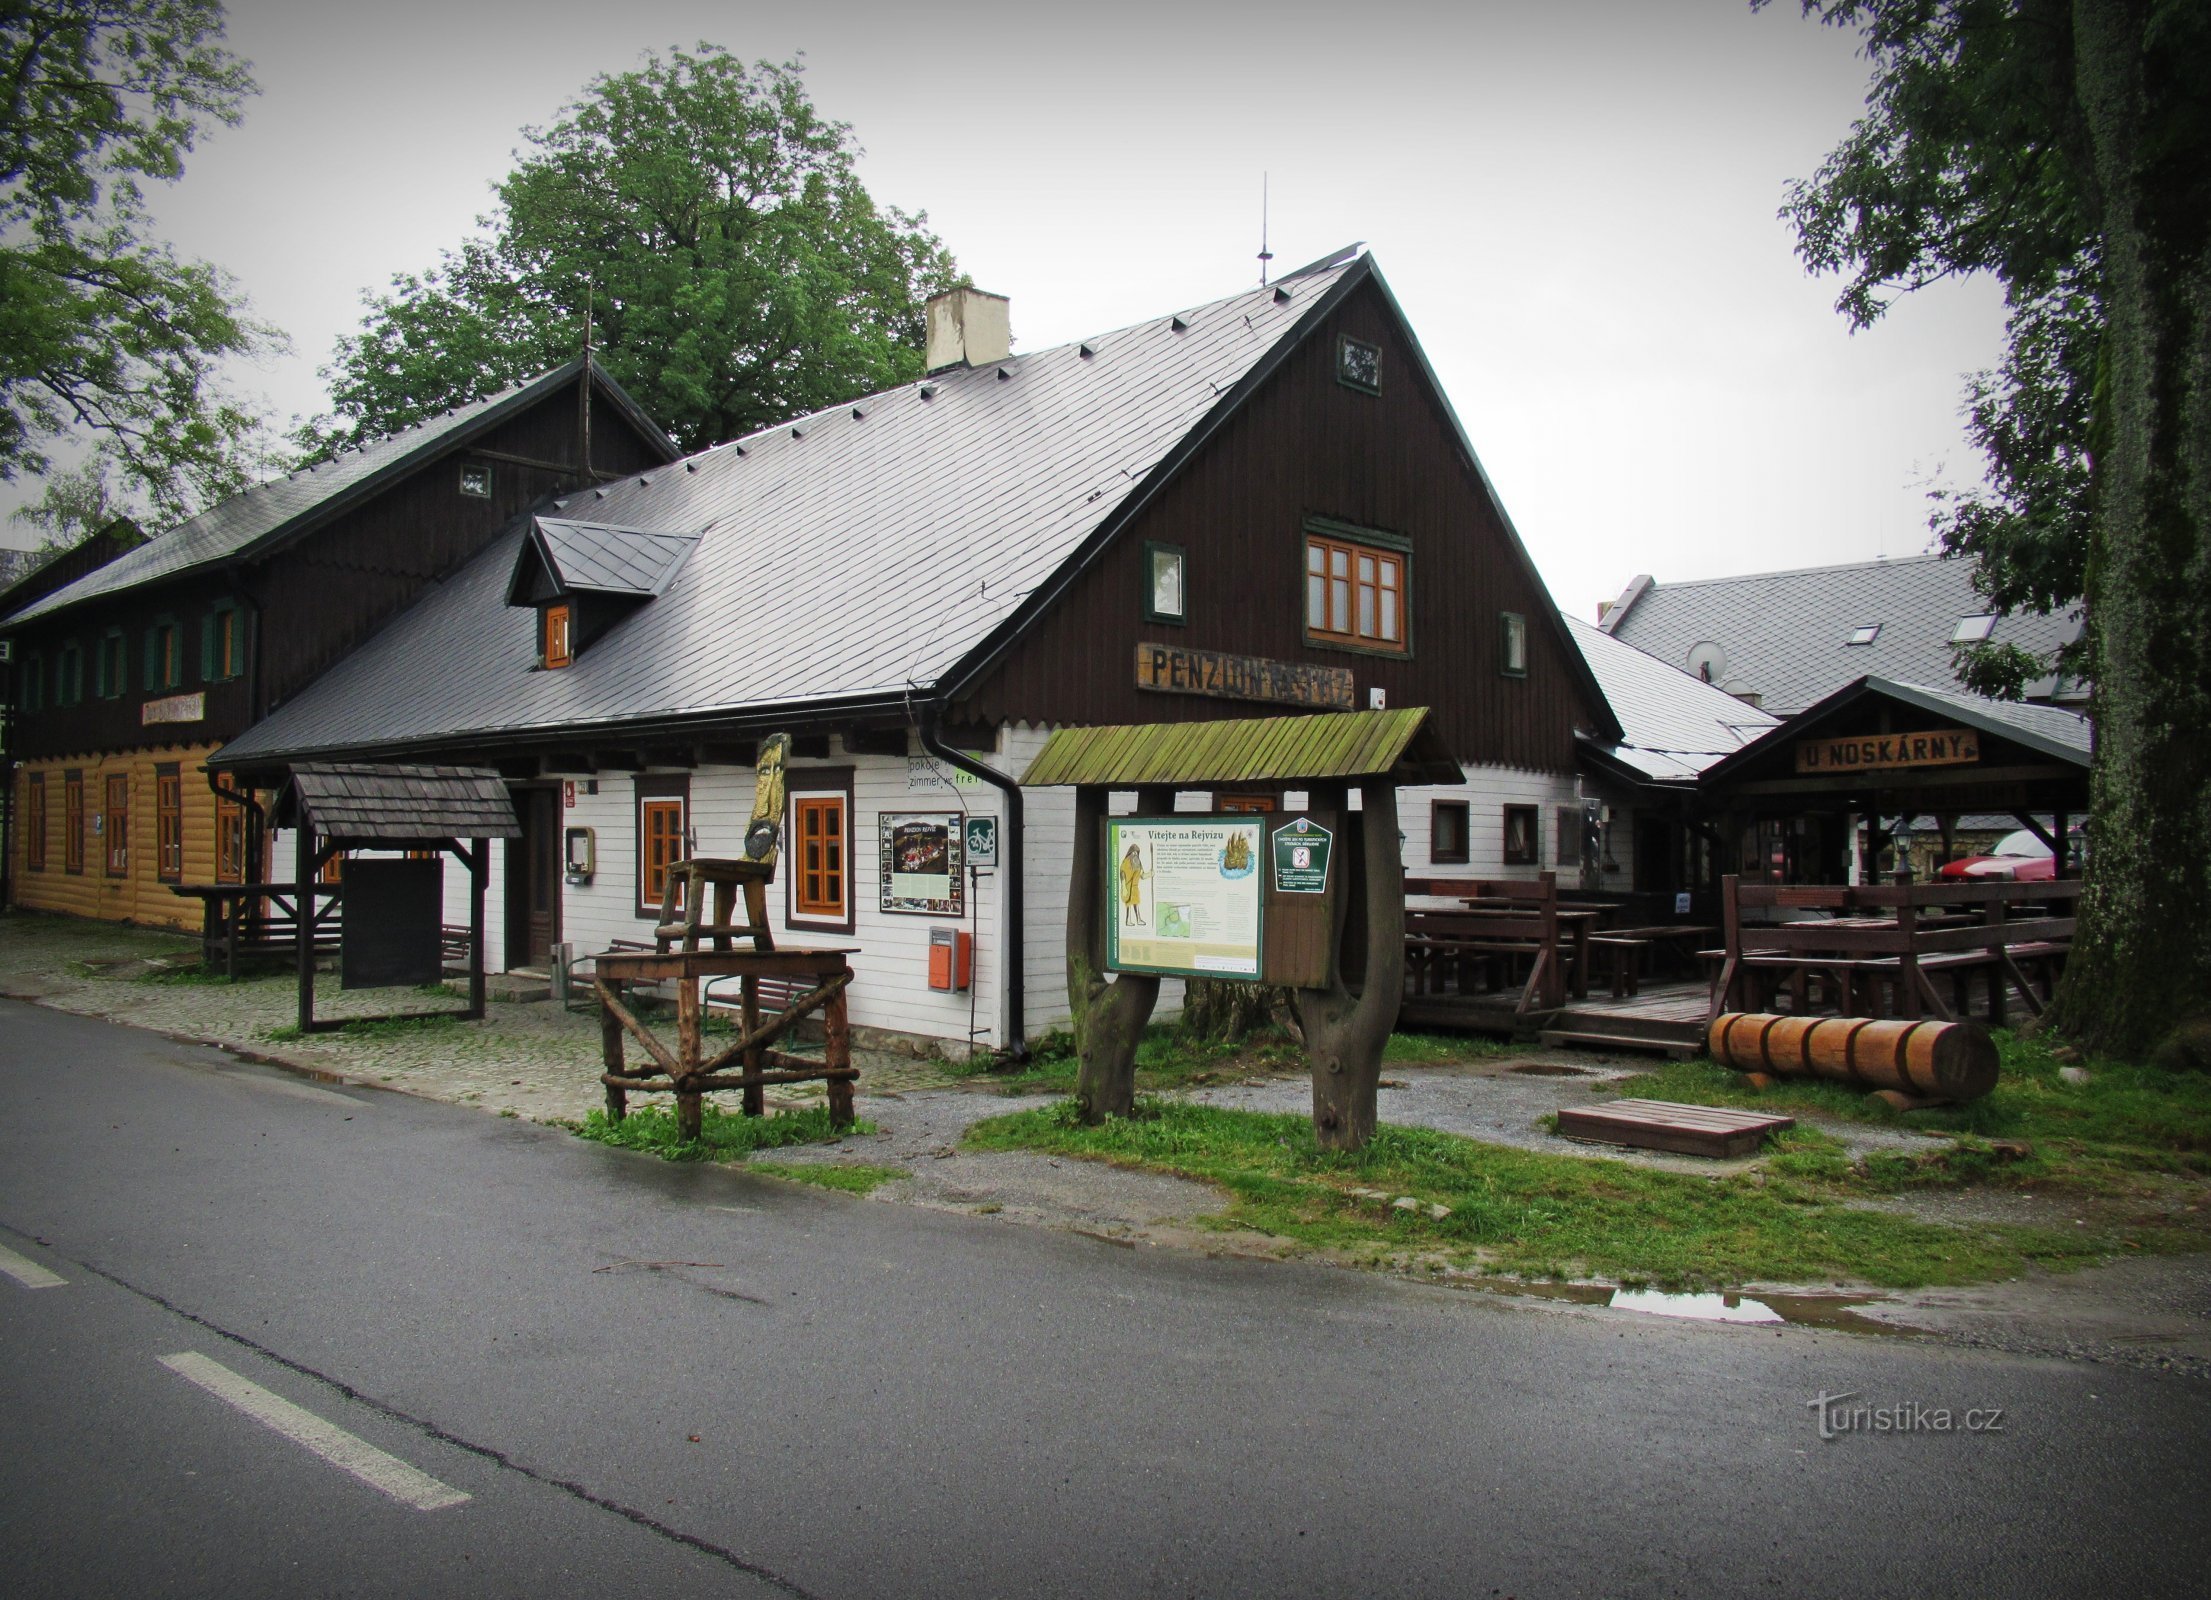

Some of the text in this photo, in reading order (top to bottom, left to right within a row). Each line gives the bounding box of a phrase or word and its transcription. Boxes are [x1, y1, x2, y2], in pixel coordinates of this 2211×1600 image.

[1152, 649, 1263, 696] PENZION
[1806, 734, 1962, 767] U NOSKÁRNY
[909, 758, 940, 773] pokoje
[909, 775, 940, 787] zimmer
